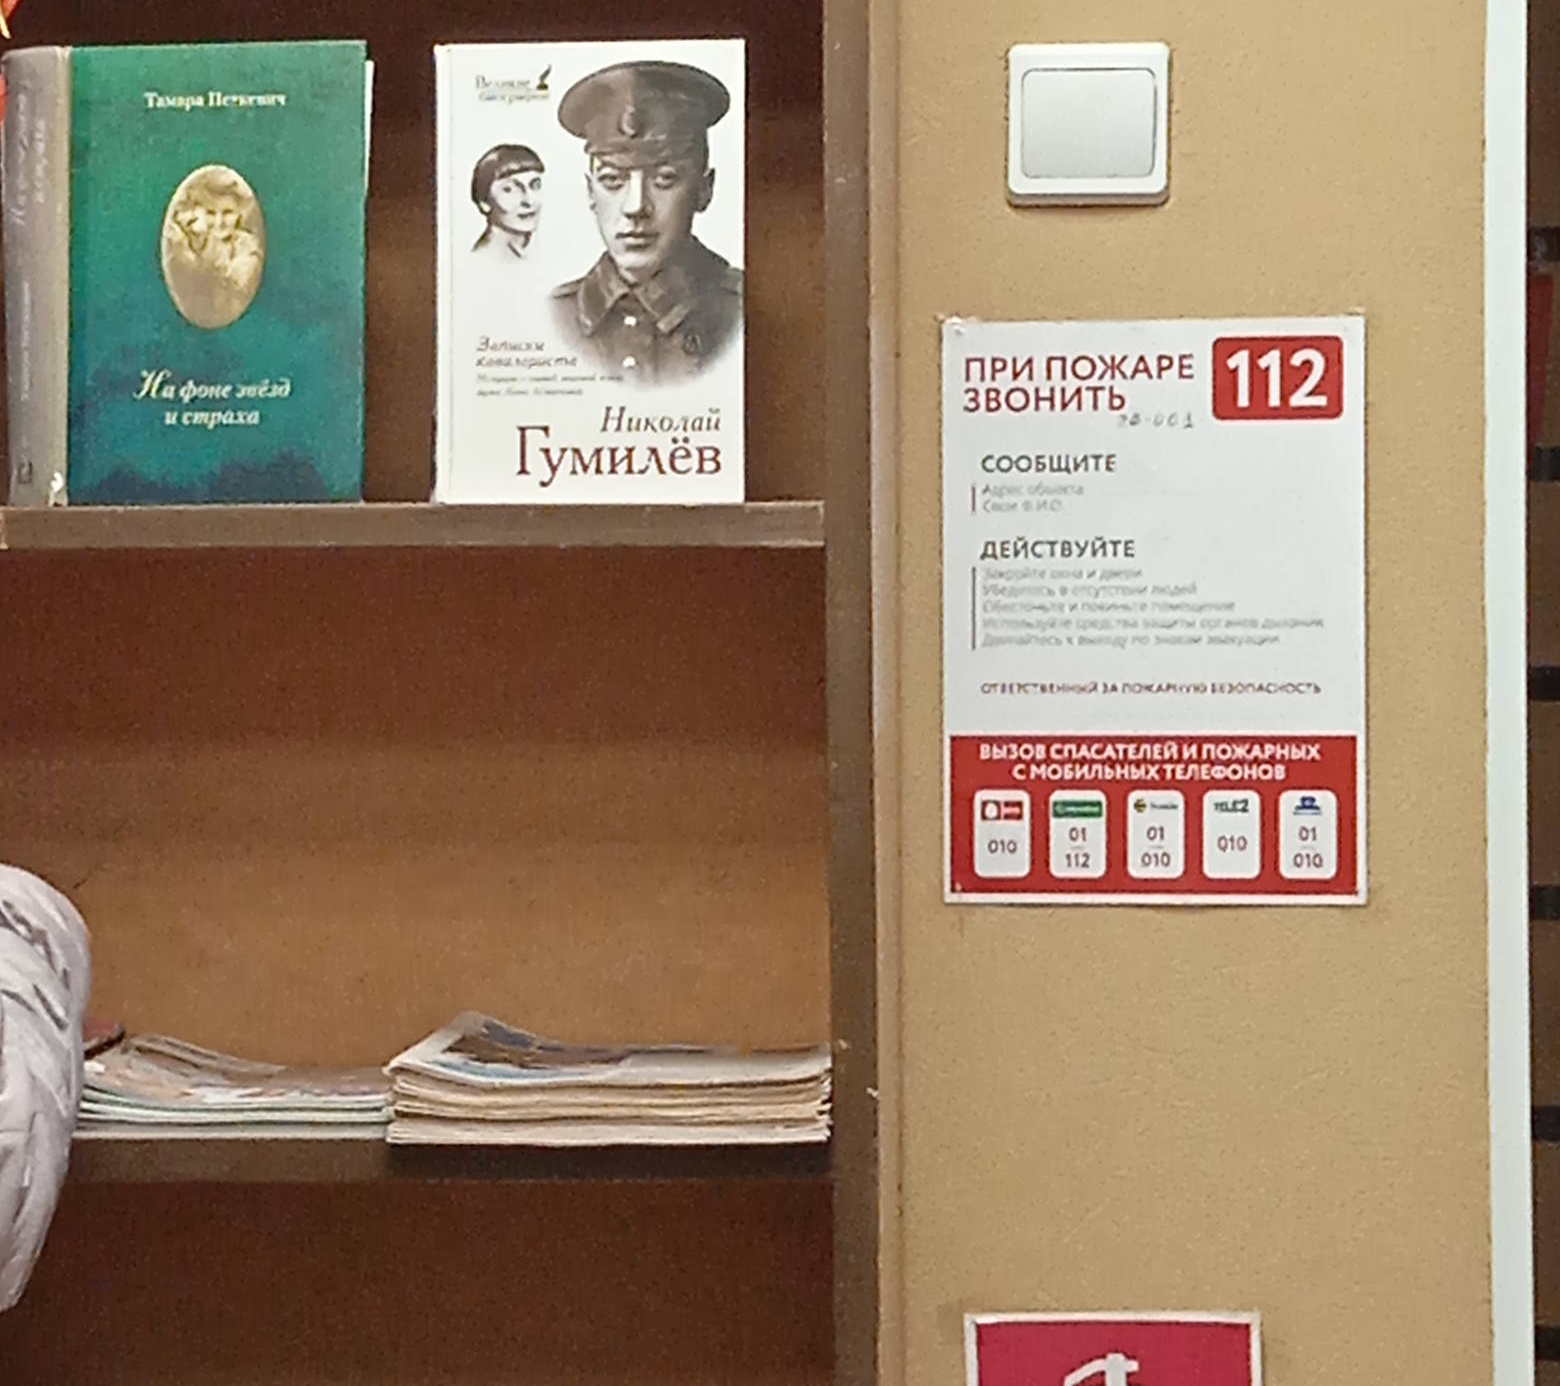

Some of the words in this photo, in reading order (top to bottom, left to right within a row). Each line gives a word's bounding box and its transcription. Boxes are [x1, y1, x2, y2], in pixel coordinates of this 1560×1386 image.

[144, 91, 206, 111] Тамара
[964, 356, 1034, 384] ПРИ
[1045, 354, 1195, 381] ПОЖАРЕ
[1226, 348, 1328, 409] 112
[133, 369, 176, 401] На
[179, 379, 231, 403] фоне
[963, 385, 1127, 413] ЗВОНИТЬ
[164, 409, 178, 425] и
[181, 407, 260, 429] страха
[600, 406, 721, 433] Николай
[516, 425, 722, 488] Гумилёв
[981, 453, 1117, 475] СООБЩИТЕ
[980, 536, 1136, 561] ДЕЙСТВУЙТЕ
[980, 680, 1098, 695] ОТВЕТСТВЕННЫЙ
[1101, 682, 1118, 694] ЗА
[1211, 682, 1322, 695] БЕЗОПАСНОСТЬ
[979, 742, 1045, 760] ВЫЗОВ
[1049, 740, 1179, 760] СПАСАТЕЛЕЙ
[1183, 743, 1200, 760] И
[1203, 742, 1321, 761] ПОЖАРНЫХ
[1012, 763, 1027, 781] С
[1030, 762, 1160, 781] МОБИЛЬНЫХ
[1163, 762, 1286, 782] ТЕЛЕФОНОВ
[1068, 826, 1087, 843] 01
[1146, 825, 1165, 842] 01
[1217, 835, 1248, 852] 010
[1298, 825, 1317, 842] 01
[987, 839, 1018, 855] 010
[1065, 852, 1091, 869] 112
[1140, 852, 1171, 868] 010
[1292, 852, 1324, 869] 010
